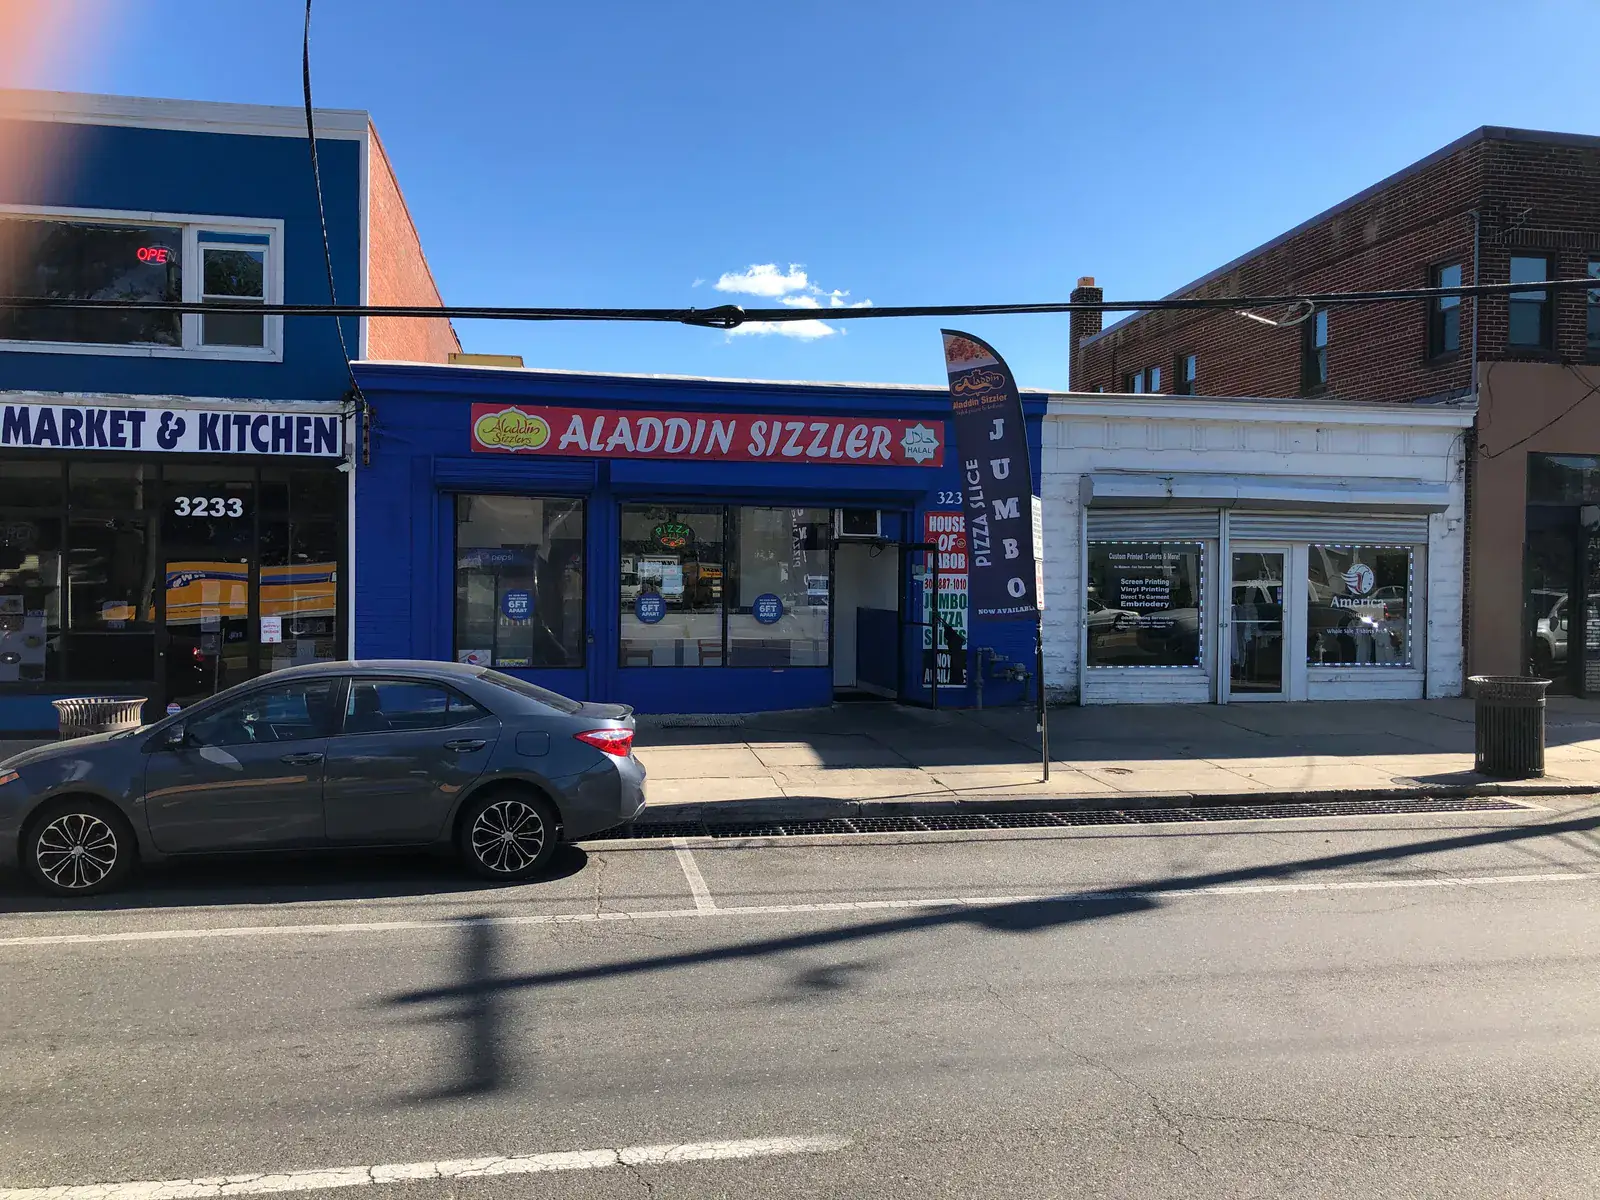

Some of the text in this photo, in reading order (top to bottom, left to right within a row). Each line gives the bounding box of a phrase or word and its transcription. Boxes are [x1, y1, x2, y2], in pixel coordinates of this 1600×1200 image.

[137, 247, 177, 262] OPEN
[953, 397, 979, 409] Aladdin
[1, 405, 338, 453] MARKET & KITCHEN
[483, 417, 540, 434] Aladdin
[492, 432, 532, 445] Sizzlers
[558, 414, 892, 460] ALADDIN SIZZLER
[905, 431, 934, 446] حلال
[907, 446, 932, 454] HALAL
[174, 496, 243, 517] 3233
[966, 459, 991, 567] PIZZA SLICE
[655, 524, 690, 535] PIZZA
[929, 515, 965, 533] HOUSE
[938, 534, 958, 551] OF
[491, 553, 514, 563] pepsi
[1144, 578, 1170, 586] Printing
[508, 600, 528, 608] 6FT
[1330, 596, 1385, 608] America
